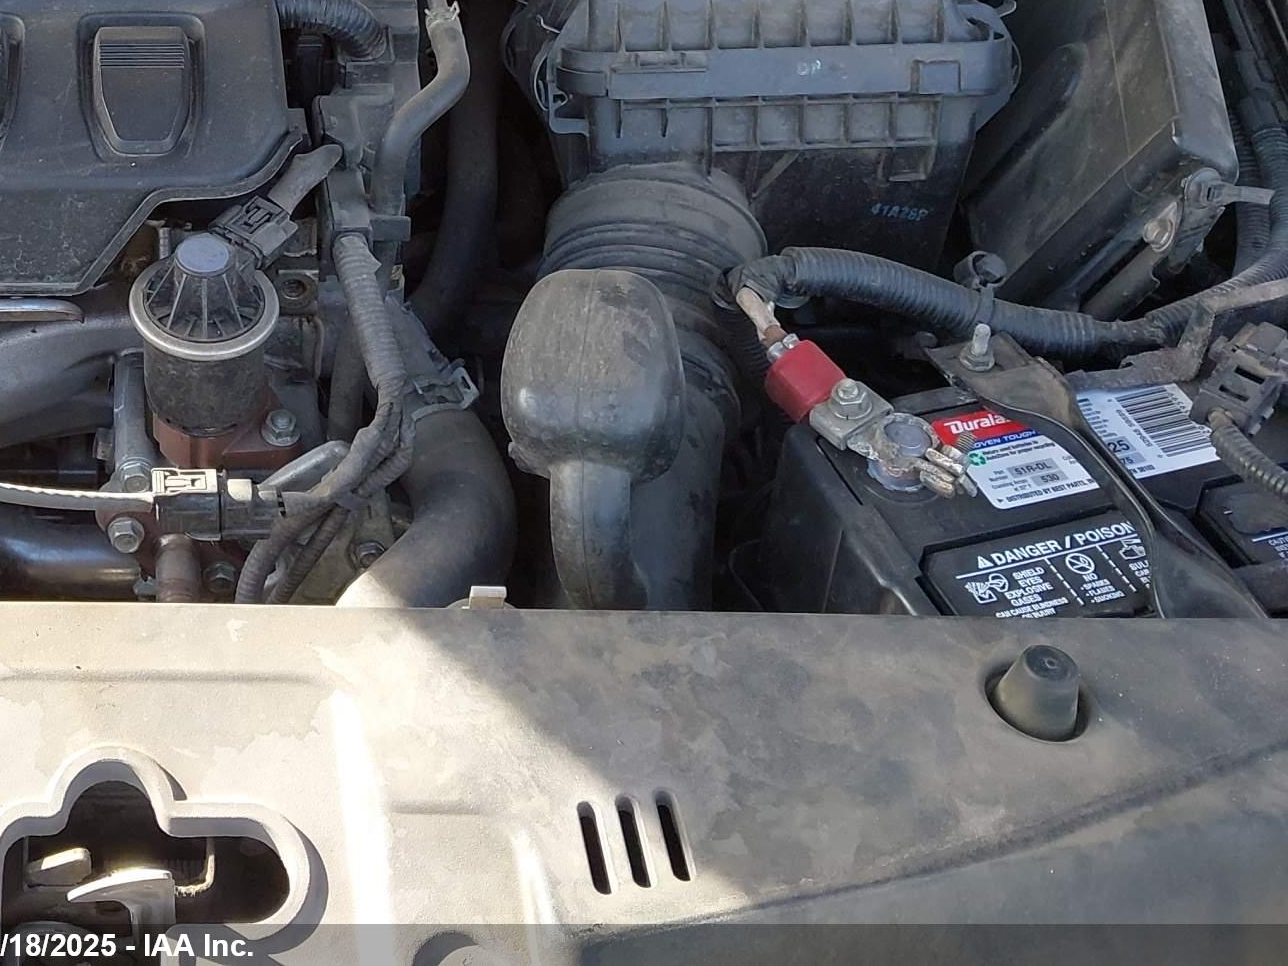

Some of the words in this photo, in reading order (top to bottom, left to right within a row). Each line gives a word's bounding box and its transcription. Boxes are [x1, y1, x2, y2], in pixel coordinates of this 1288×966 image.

[971, 436, 1001, 448] OVEN
[1040, 473, 1060, 483] 530
[991, 539, 1062, 565] DANGER
[1073, 520, 1136, 545] POISON
[1128, 559, 1150, 571] SUL
[1012, 567, 1045, 580] SHIELD
[1082, 572, 1099, 582] NO
[1018, 576, 1043, 588] EYES
[1004, 581, 1054, 600] EXPLOSIVE
[1010, 593, 1042, 607] GASES
